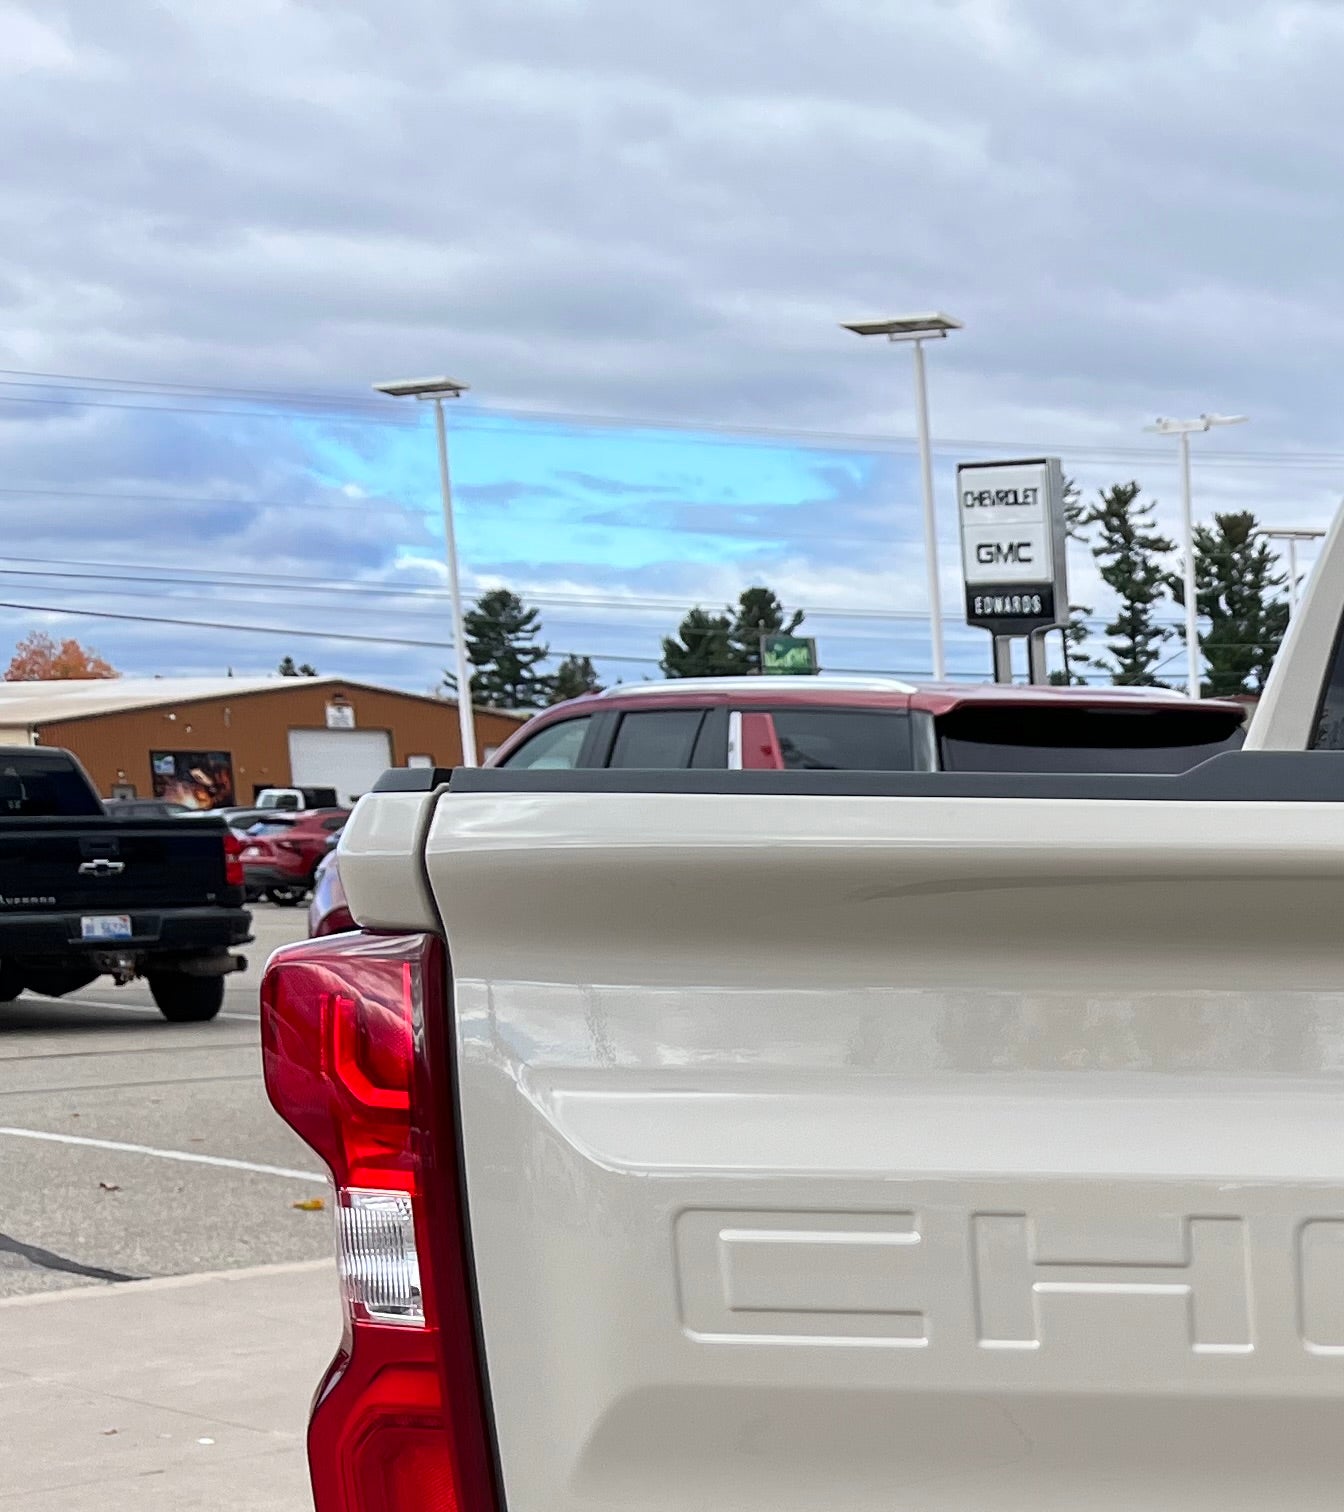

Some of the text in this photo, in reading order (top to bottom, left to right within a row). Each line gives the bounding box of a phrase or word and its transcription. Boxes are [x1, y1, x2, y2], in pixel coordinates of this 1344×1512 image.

[964, 488, 1038, 507] CHEVROLET
[977, 542, 1032, 563] GMC
[974, 595, 1042, 614] EDWARDS
